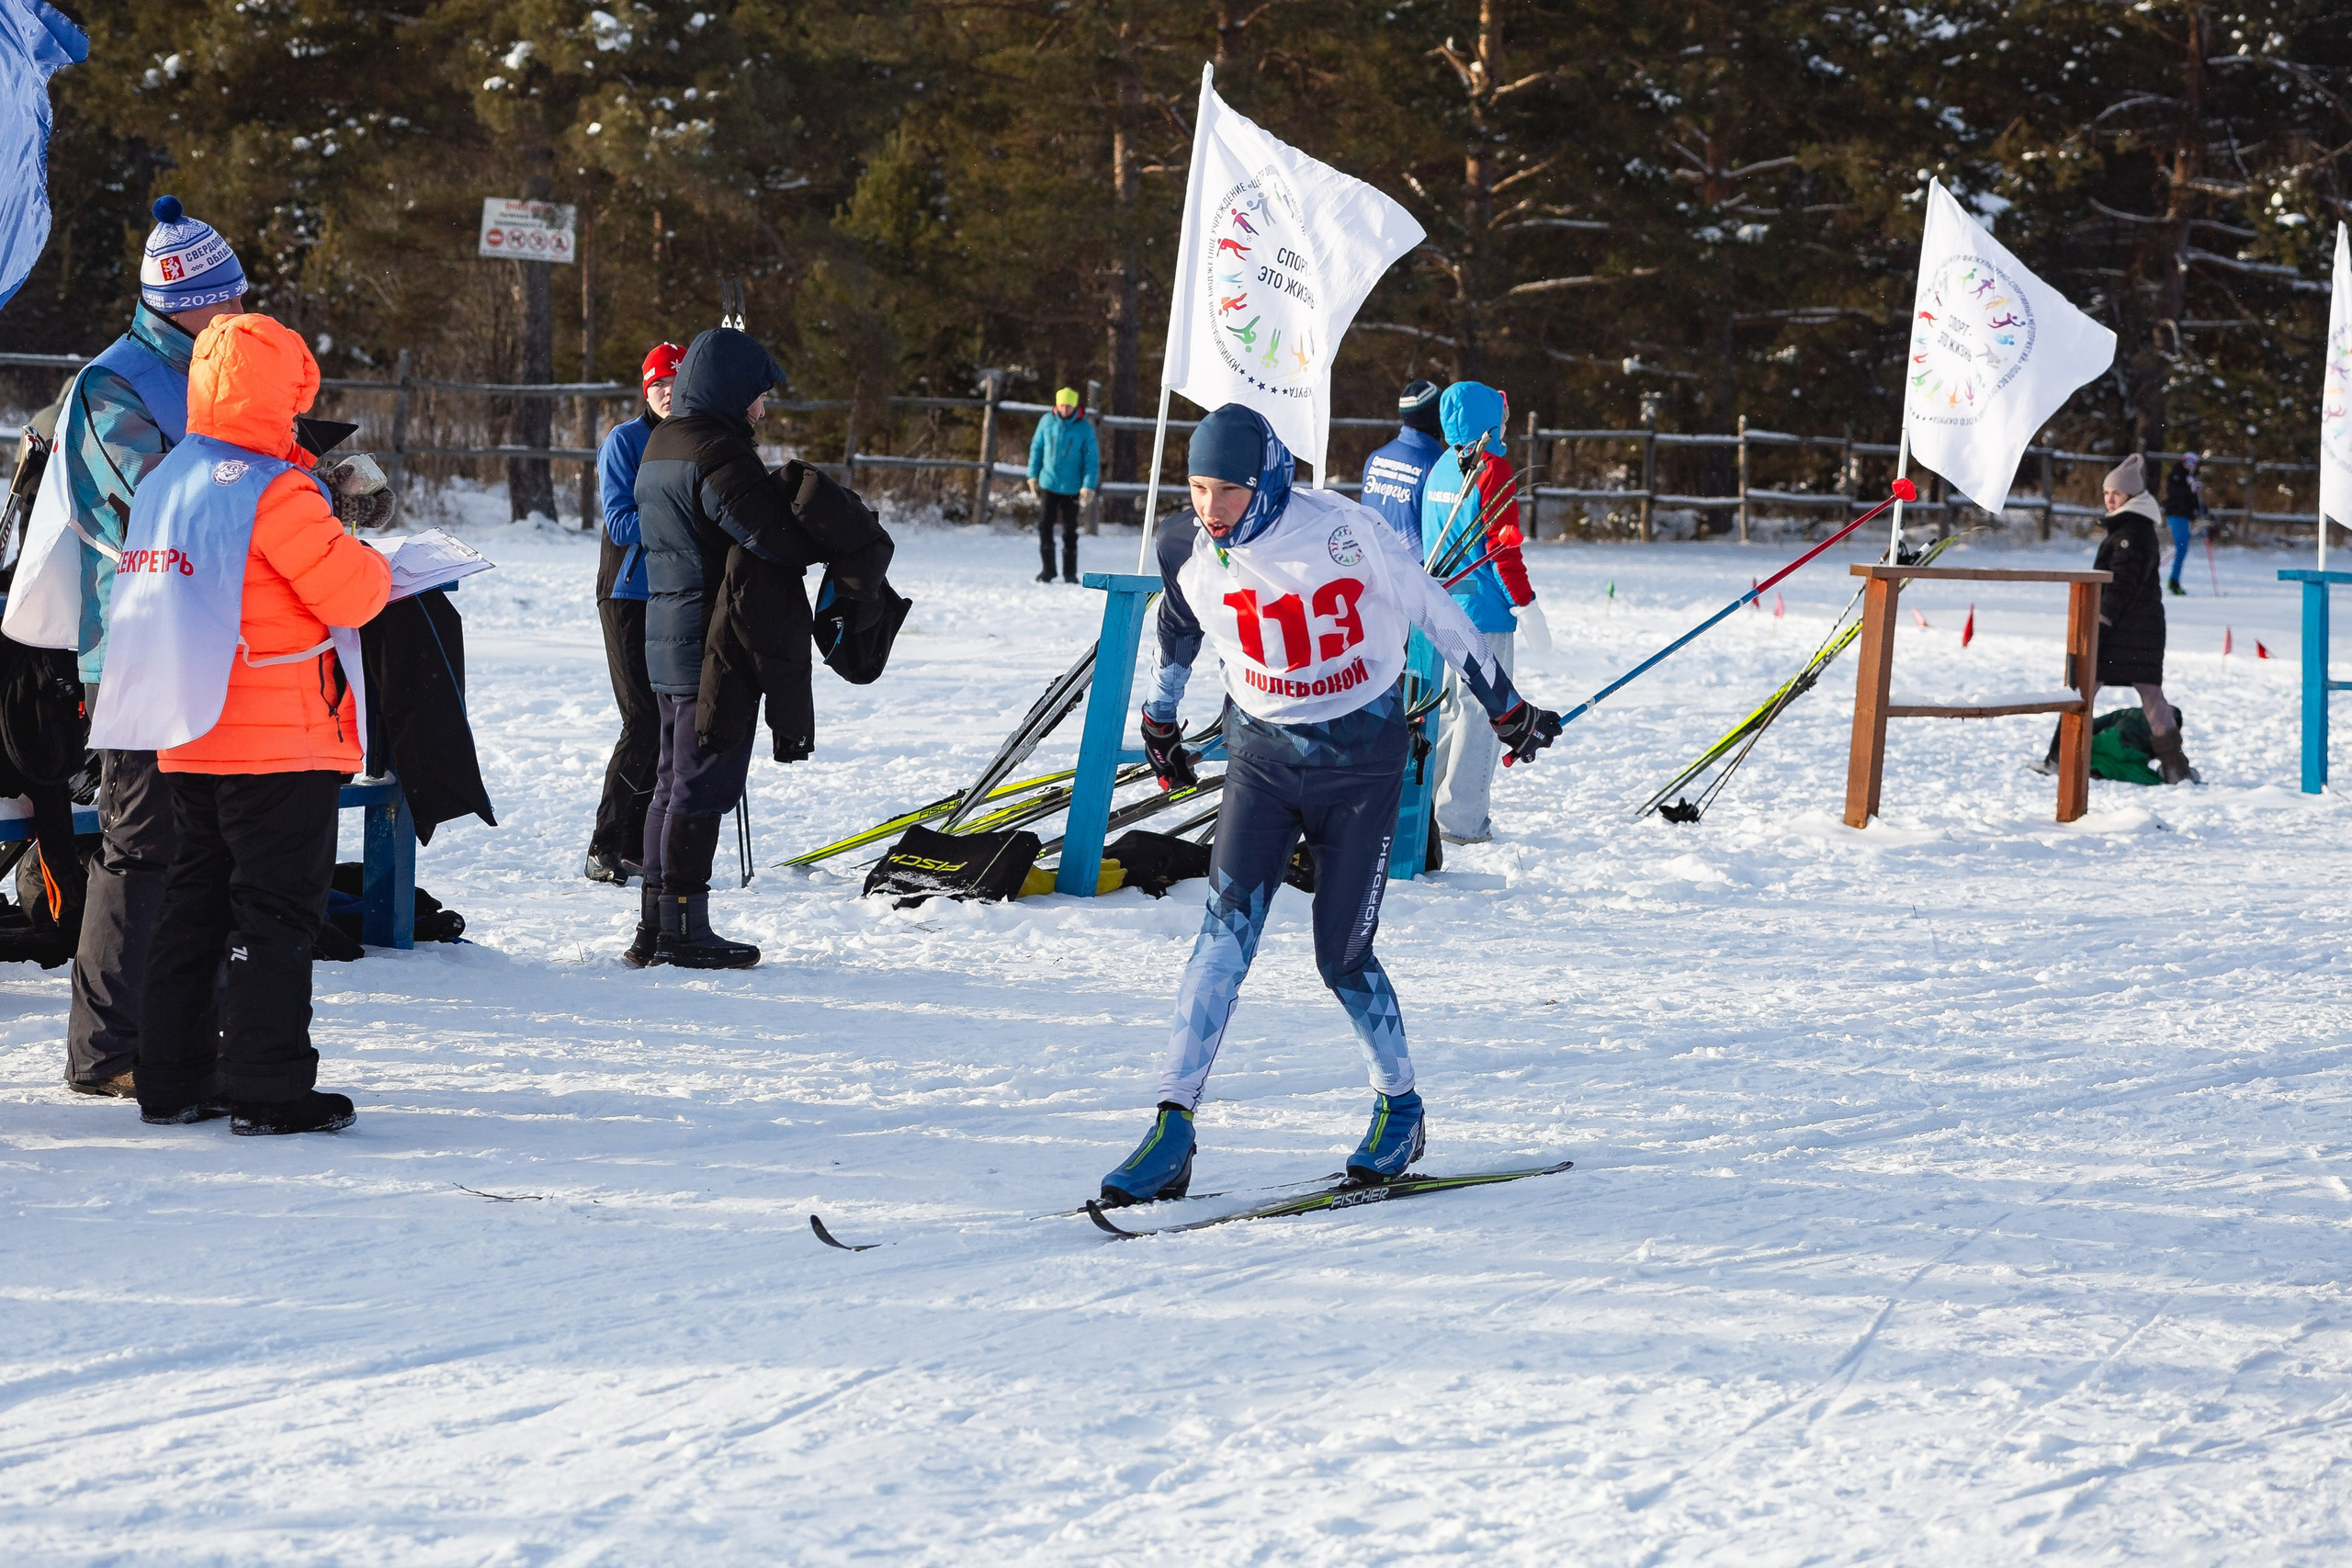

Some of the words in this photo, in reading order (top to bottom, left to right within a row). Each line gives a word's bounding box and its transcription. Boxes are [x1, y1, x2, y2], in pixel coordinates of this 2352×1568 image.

[1276, 246, 1309, 277] СПОРТ
[178, 290, 230, 308] 2025
[1257, 265, 1283, 289] ЭТО
[1283, 276, 1316, 310] ЖИЗНЬ
[1363, 475, 1412, 506] Энергия
[1223, 578, 1365, 673] 113
[1245, 655, 1370, 698] ПОЛЕВСКОЙ
[1361, 836, 1391, 937] NORDSKI
[1330, 1187, 1390, 1209] FISCHER
